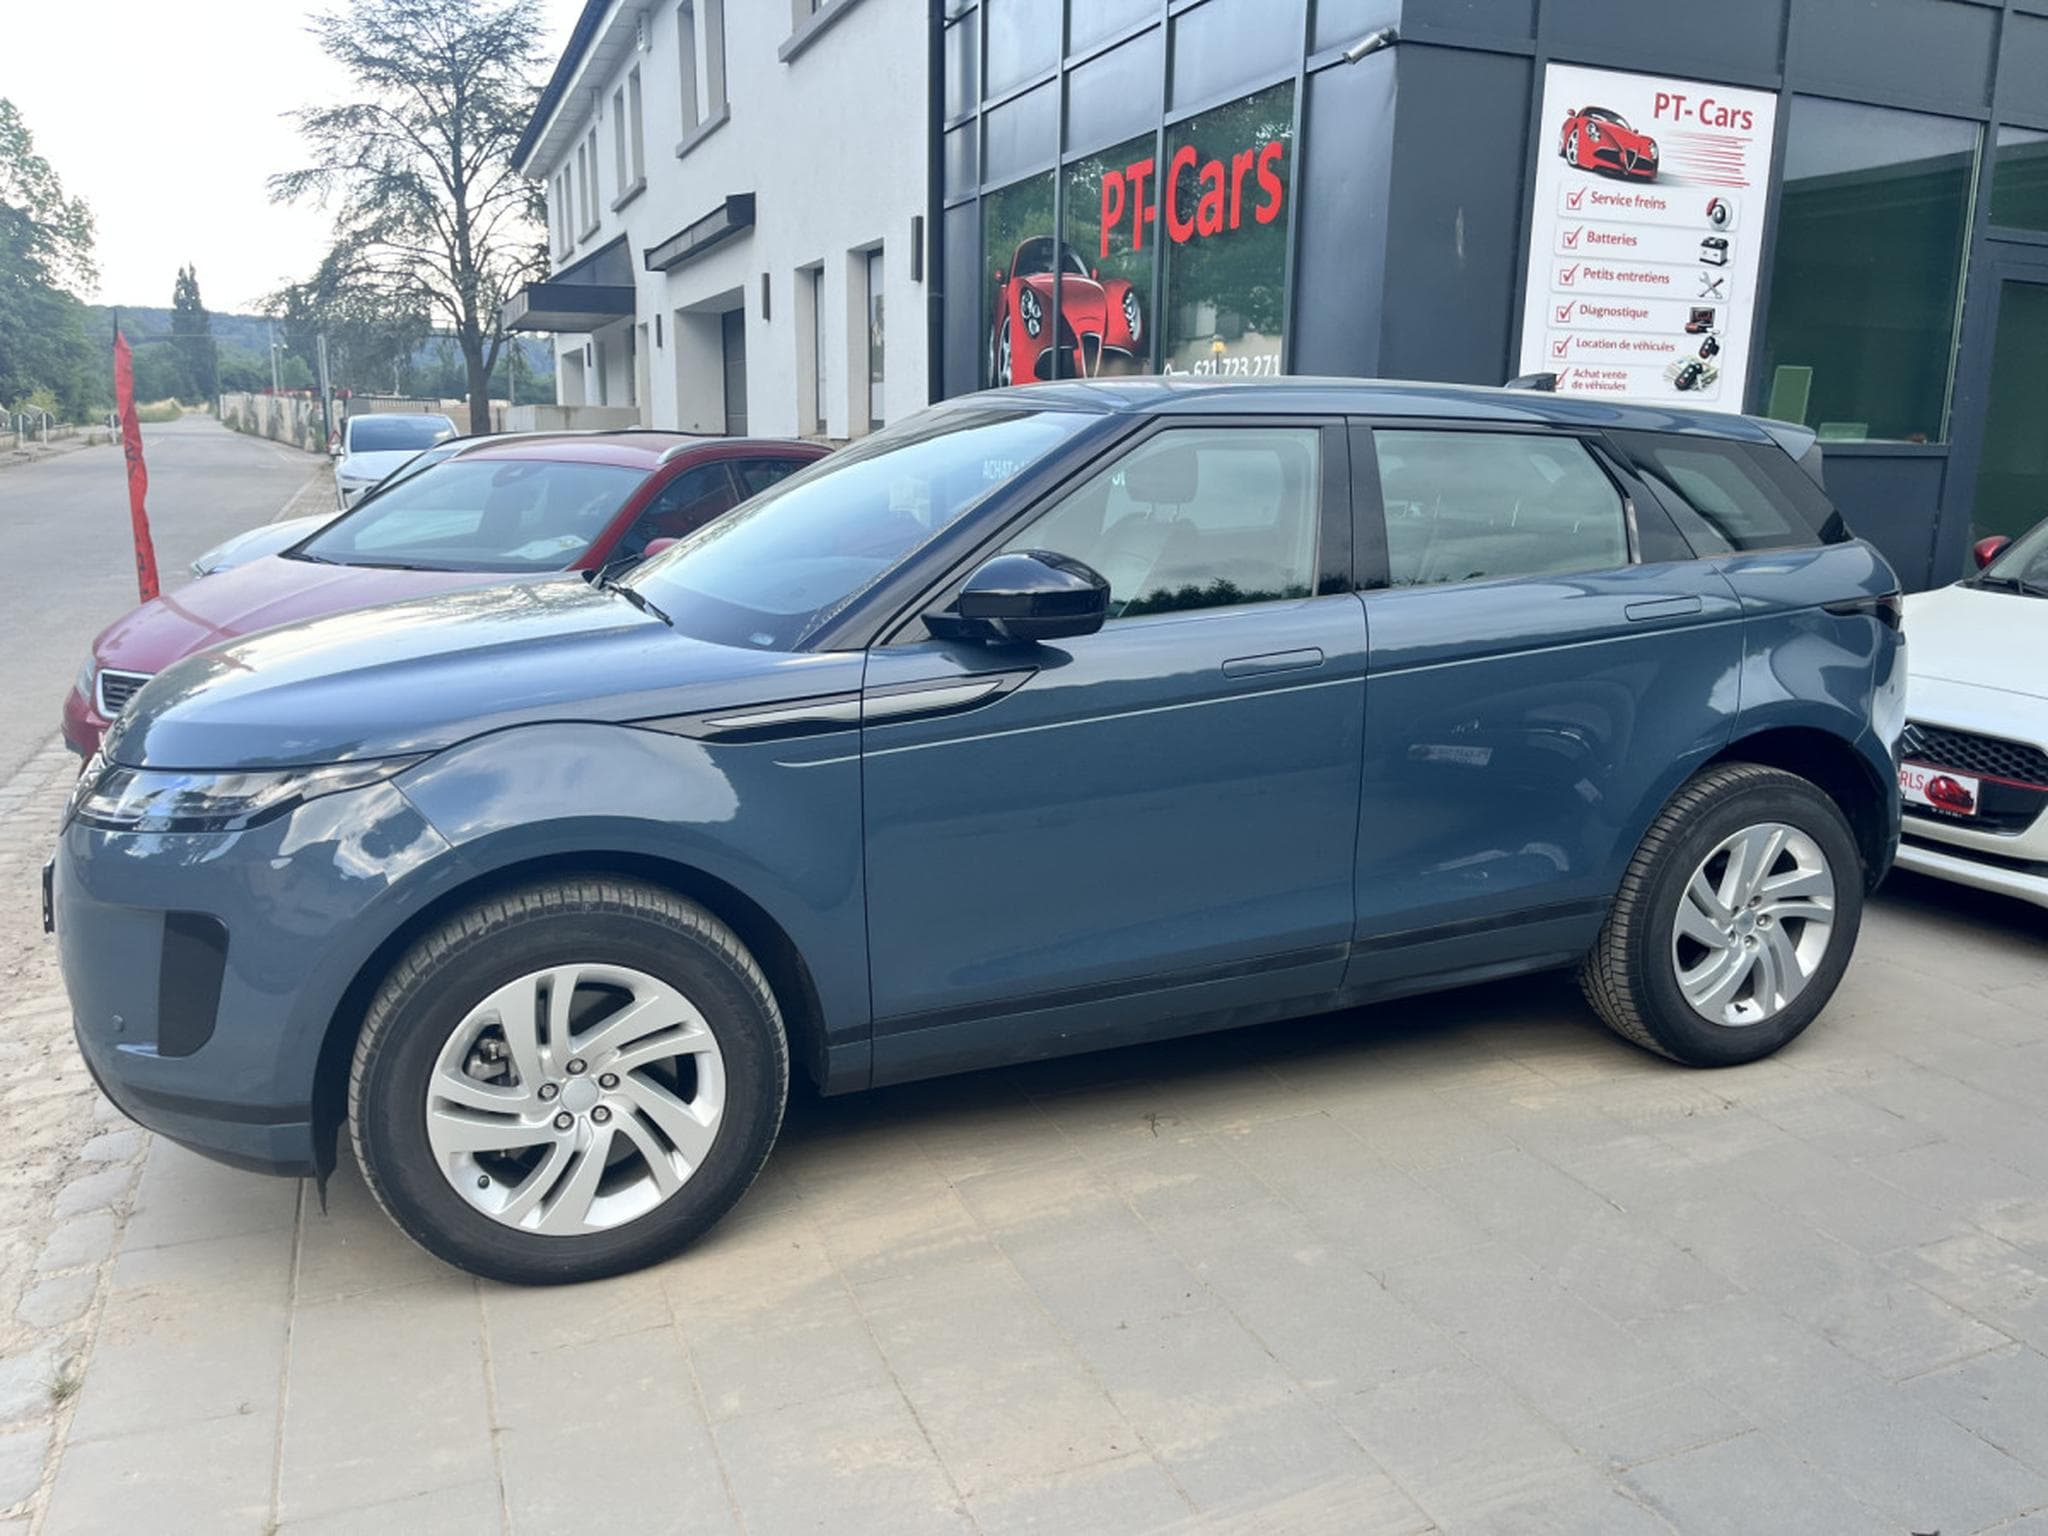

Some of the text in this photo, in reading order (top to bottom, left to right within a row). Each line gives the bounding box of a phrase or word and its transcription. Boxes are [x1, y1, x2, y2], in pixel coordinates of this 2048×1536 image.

[1590, 190, 1667, 210] Service freins
[1586, 231, 1638, 247] Batteries
[1583, 267, 1670, 285] Petits entretiens
[1579, 304, 1649, 321] Diagnostique
[1576, 338, 1676, 352] Location de véhicules
[1573, 368, 1628, 380] Achat vente
[1571, 380, 1626, 391] de véhicules
